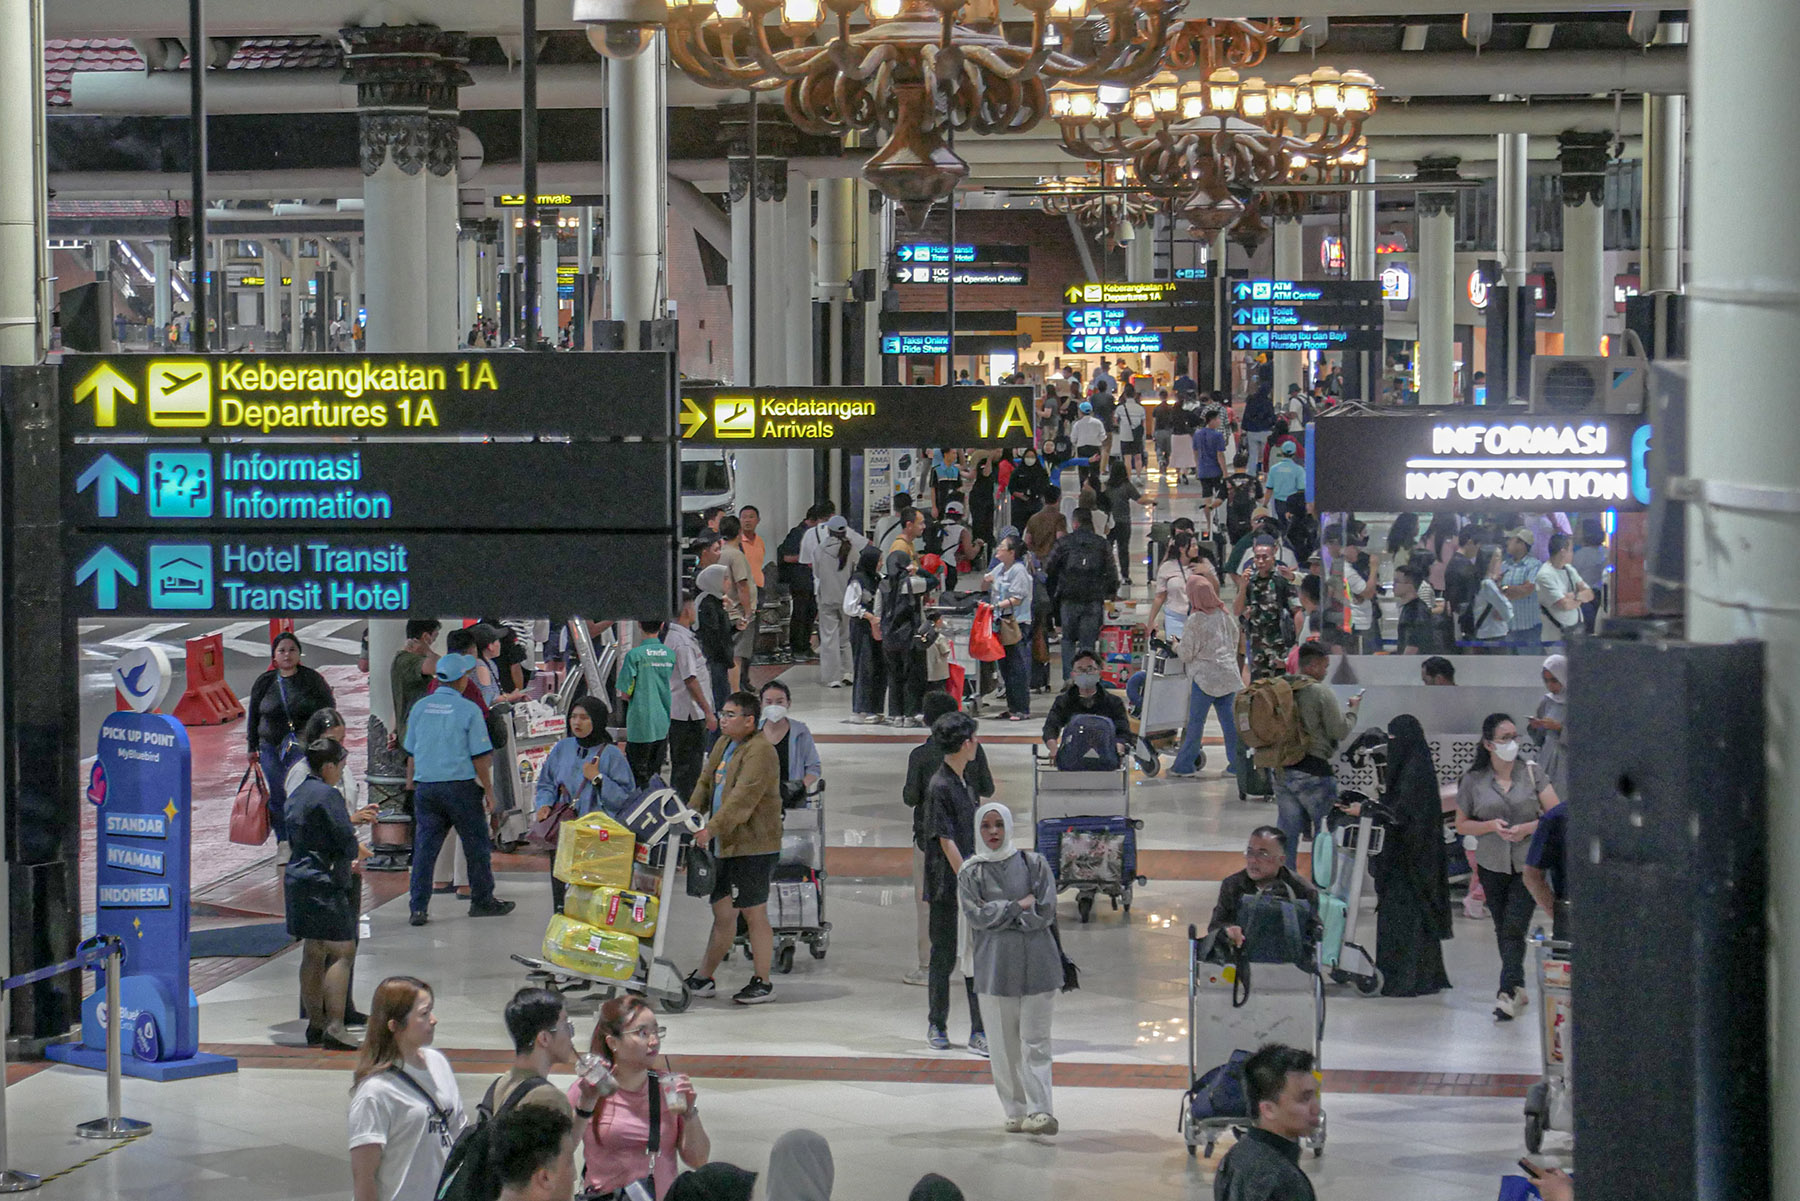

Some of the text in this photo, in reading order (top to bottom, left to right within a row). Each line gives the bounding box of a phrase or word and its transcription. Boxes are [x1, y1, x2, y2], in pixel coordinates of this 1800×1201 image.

[931, 246, 974, 254] Hote ransit
[932, 268, 949, 276] TOC
[963, 275, 997, 285] Operation
[997, 275, 1022, 283] Center
[1103, 283, 1176, 293] Keberangkatan 1A
[1272, 282, 1292, 290] ATM
[1103, 293, 1161, 303] Departures 1A
[1272, 291, 1320, 300] ATM Center
[1103, 310, 1125, 318] Taksi
[1272, 307, 1293, 315] Toilet
[1104, 319, 1120, 327] Taxi
[1272, 316, 1298, 325] Toilets
[902, 337, 923, 345] Taksi
[1104, 335, 1159, 343] Area Merokok
[1271, 332, 1347, 342] Ruang Ibu dan Bayi
[902, 345, 947, 353] Ride Share
[1104, 344, 1160, 353] Smoking Area
[1271, 341, 1328, 350] Nursery Room
[219, 361, 498, 398] Keberangkatan 1A
[220, 398, 439, 433] Departures 1A
[761, 396, 1034, 439] Kedatangan 1A
[762, 421, 834, 438] Arrivals
[1432, 424, 1608, 455] INFORMASI
[222, 451, 361, 481] Informasi
[1405, 471, 1628, 501] INFORMATION
[222, 488, 392, 520] Information
[222, 544, 408, 573] Hotel Transit
[222, 581, 410, 611] Transit Hotel
[102, 726, 175, 747] PICK UP POINT
[117, 747, 160, 763] MyBluebird
[106, 815, 164, 834] STANDAR
[107, 847, 161, 871] NYAMAN
[100, 886, 168, 903] INDONESIA
